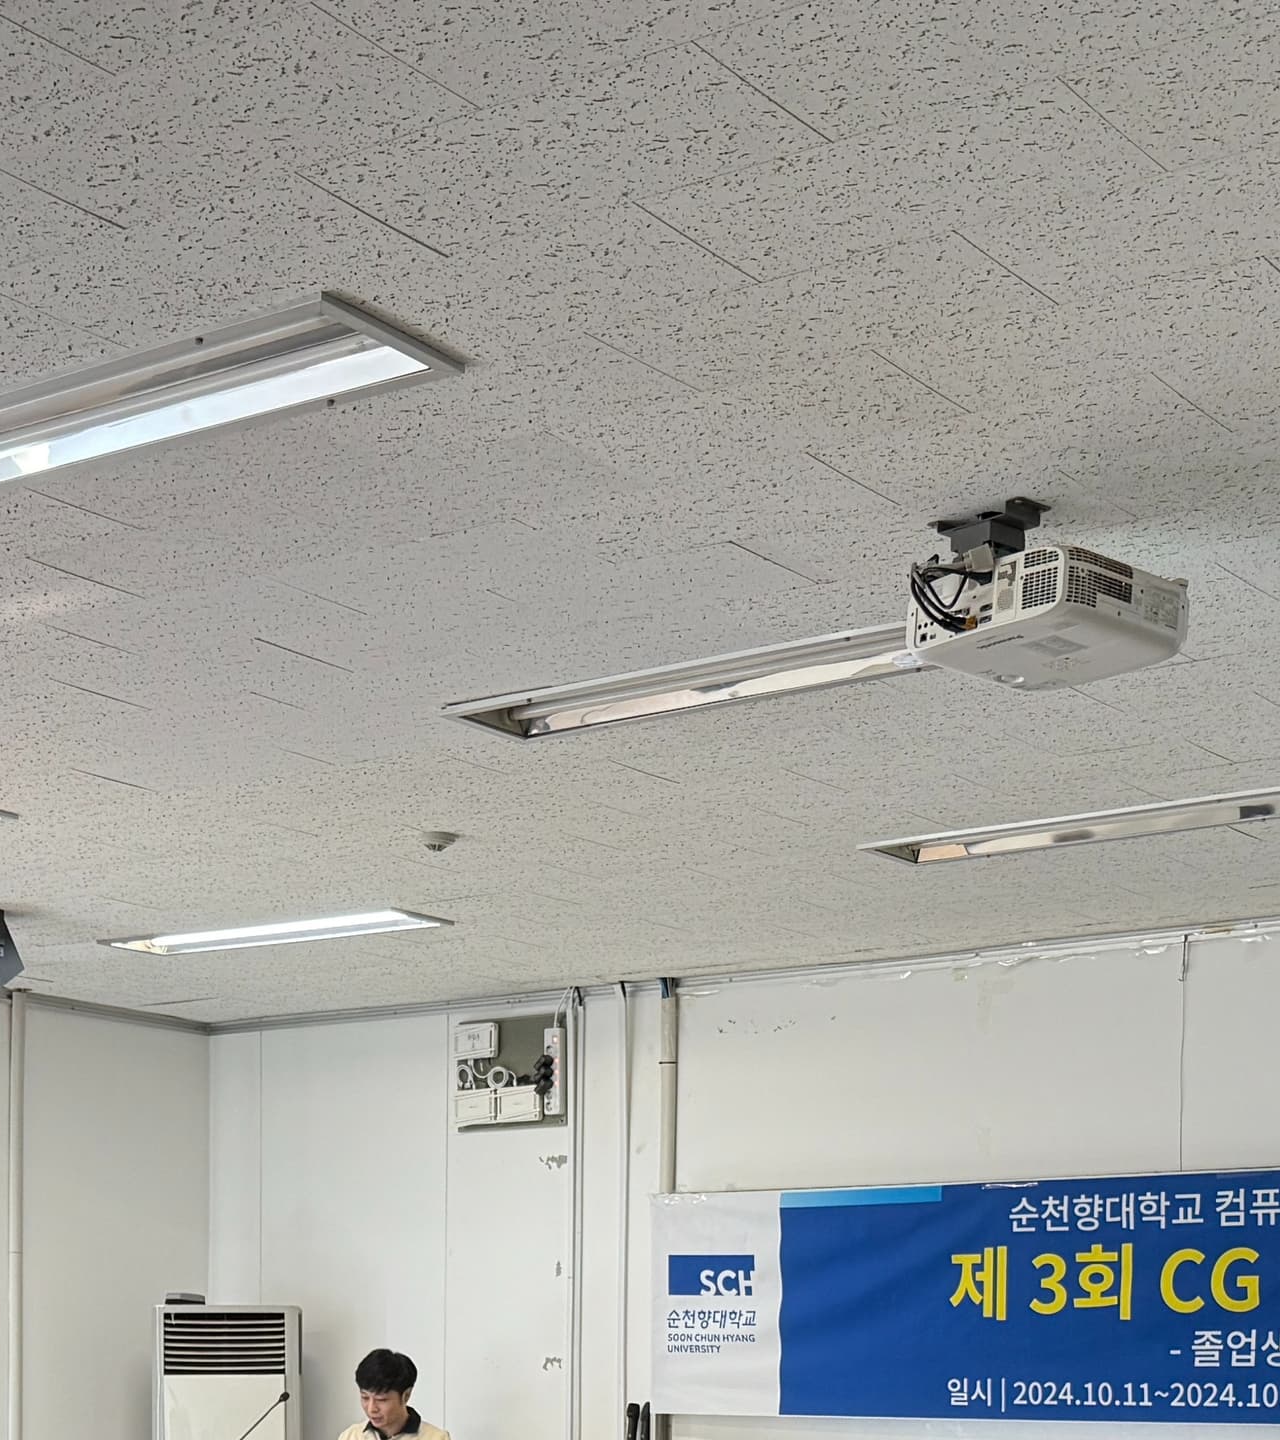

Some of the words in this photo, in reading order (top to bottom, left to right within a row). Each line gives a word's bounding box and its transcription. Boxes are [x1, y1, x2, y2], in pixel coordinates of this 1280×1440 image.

[1009, 1191, 1204, 1233] 순천향대학교
[700, 1269, 755, 1297] SCH
[949, 1245, 1008, 1321] 제
[1028, 1242, 1134, 1321] 3회
[1159, 1246, 1261, 1314] CG
[666, 1309, 757, 1329] 순천향대학교
[667, 1333, 693, 1342] SOON
[694, 1333, 721, 1343] CHUN
[722, 1334, 756, 1343] HYANG
[667, 1344, 721, 1353] UNIVERSITY
[946, 1377, 993, 1407] 일시
